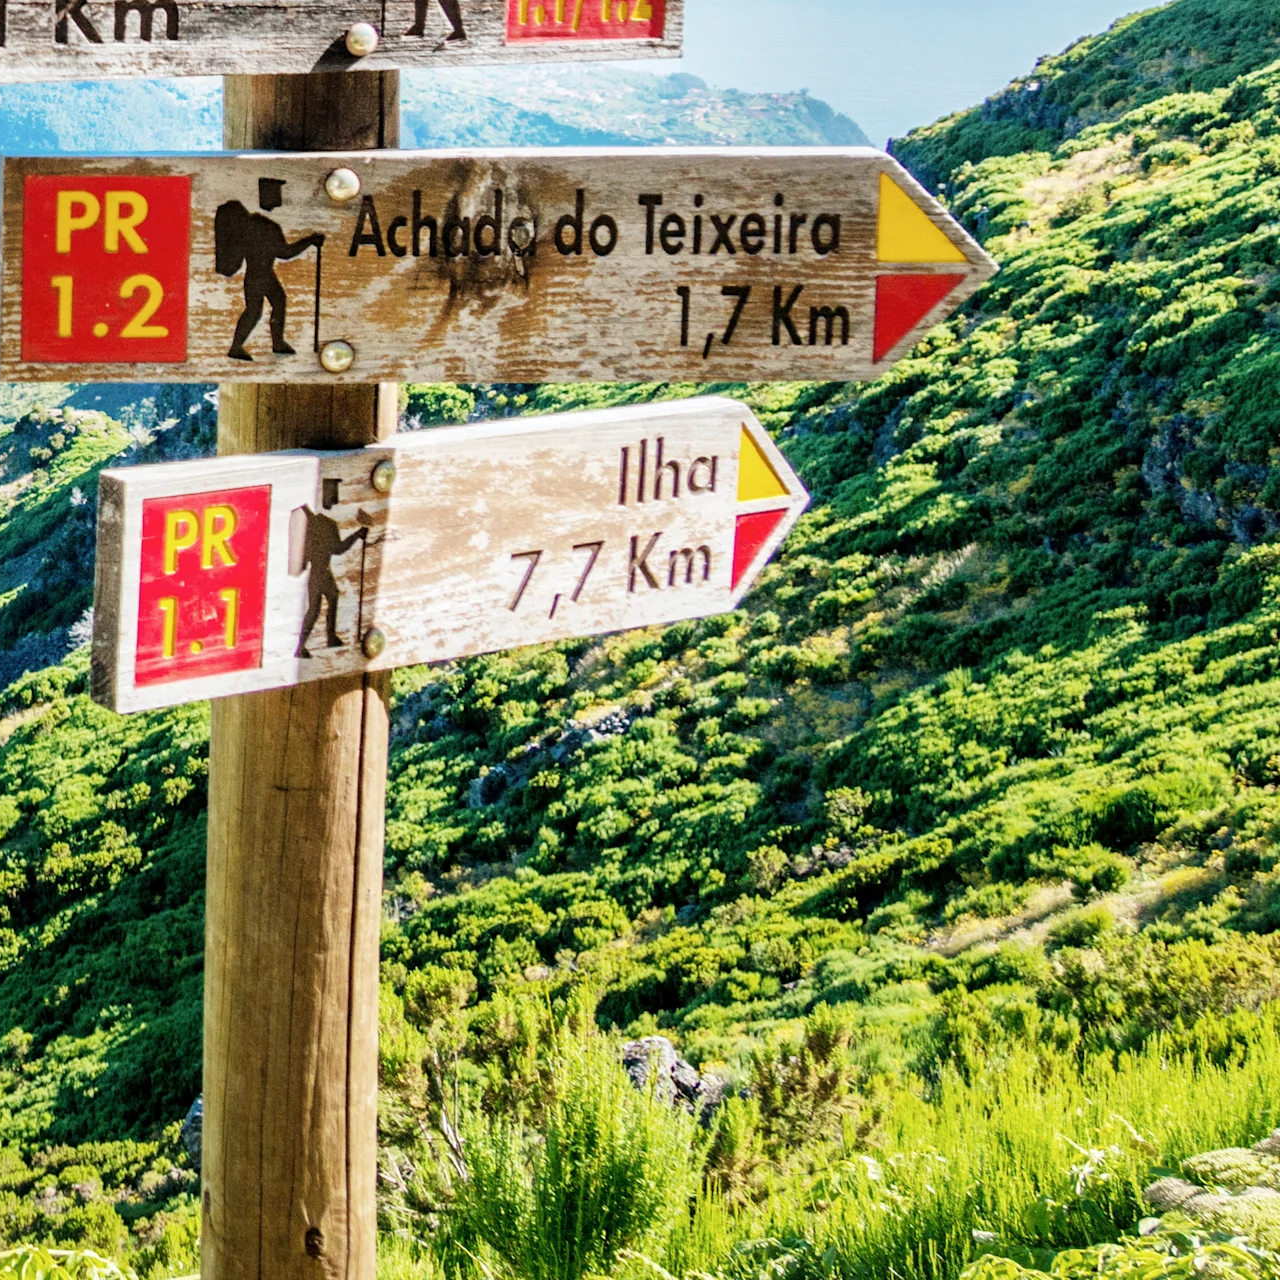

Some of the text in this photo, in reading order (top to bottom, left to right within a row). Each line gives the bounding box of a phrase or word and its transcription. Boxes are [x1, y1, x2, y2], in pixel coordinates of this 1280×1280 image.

[54, 189, 149, 254] PR
[348, 189, 841, 258] Achada do Teixeira
[51, 273, 169, 338] 1.2
[675, 283, 852, 360] 1,7 Km
[617, 435, 719, 506] Ilha
[163, 504, 240, 576] PR
[510, 531, 712, 619] 7,7 Km
[158, 587, 240, 660] 1.1
